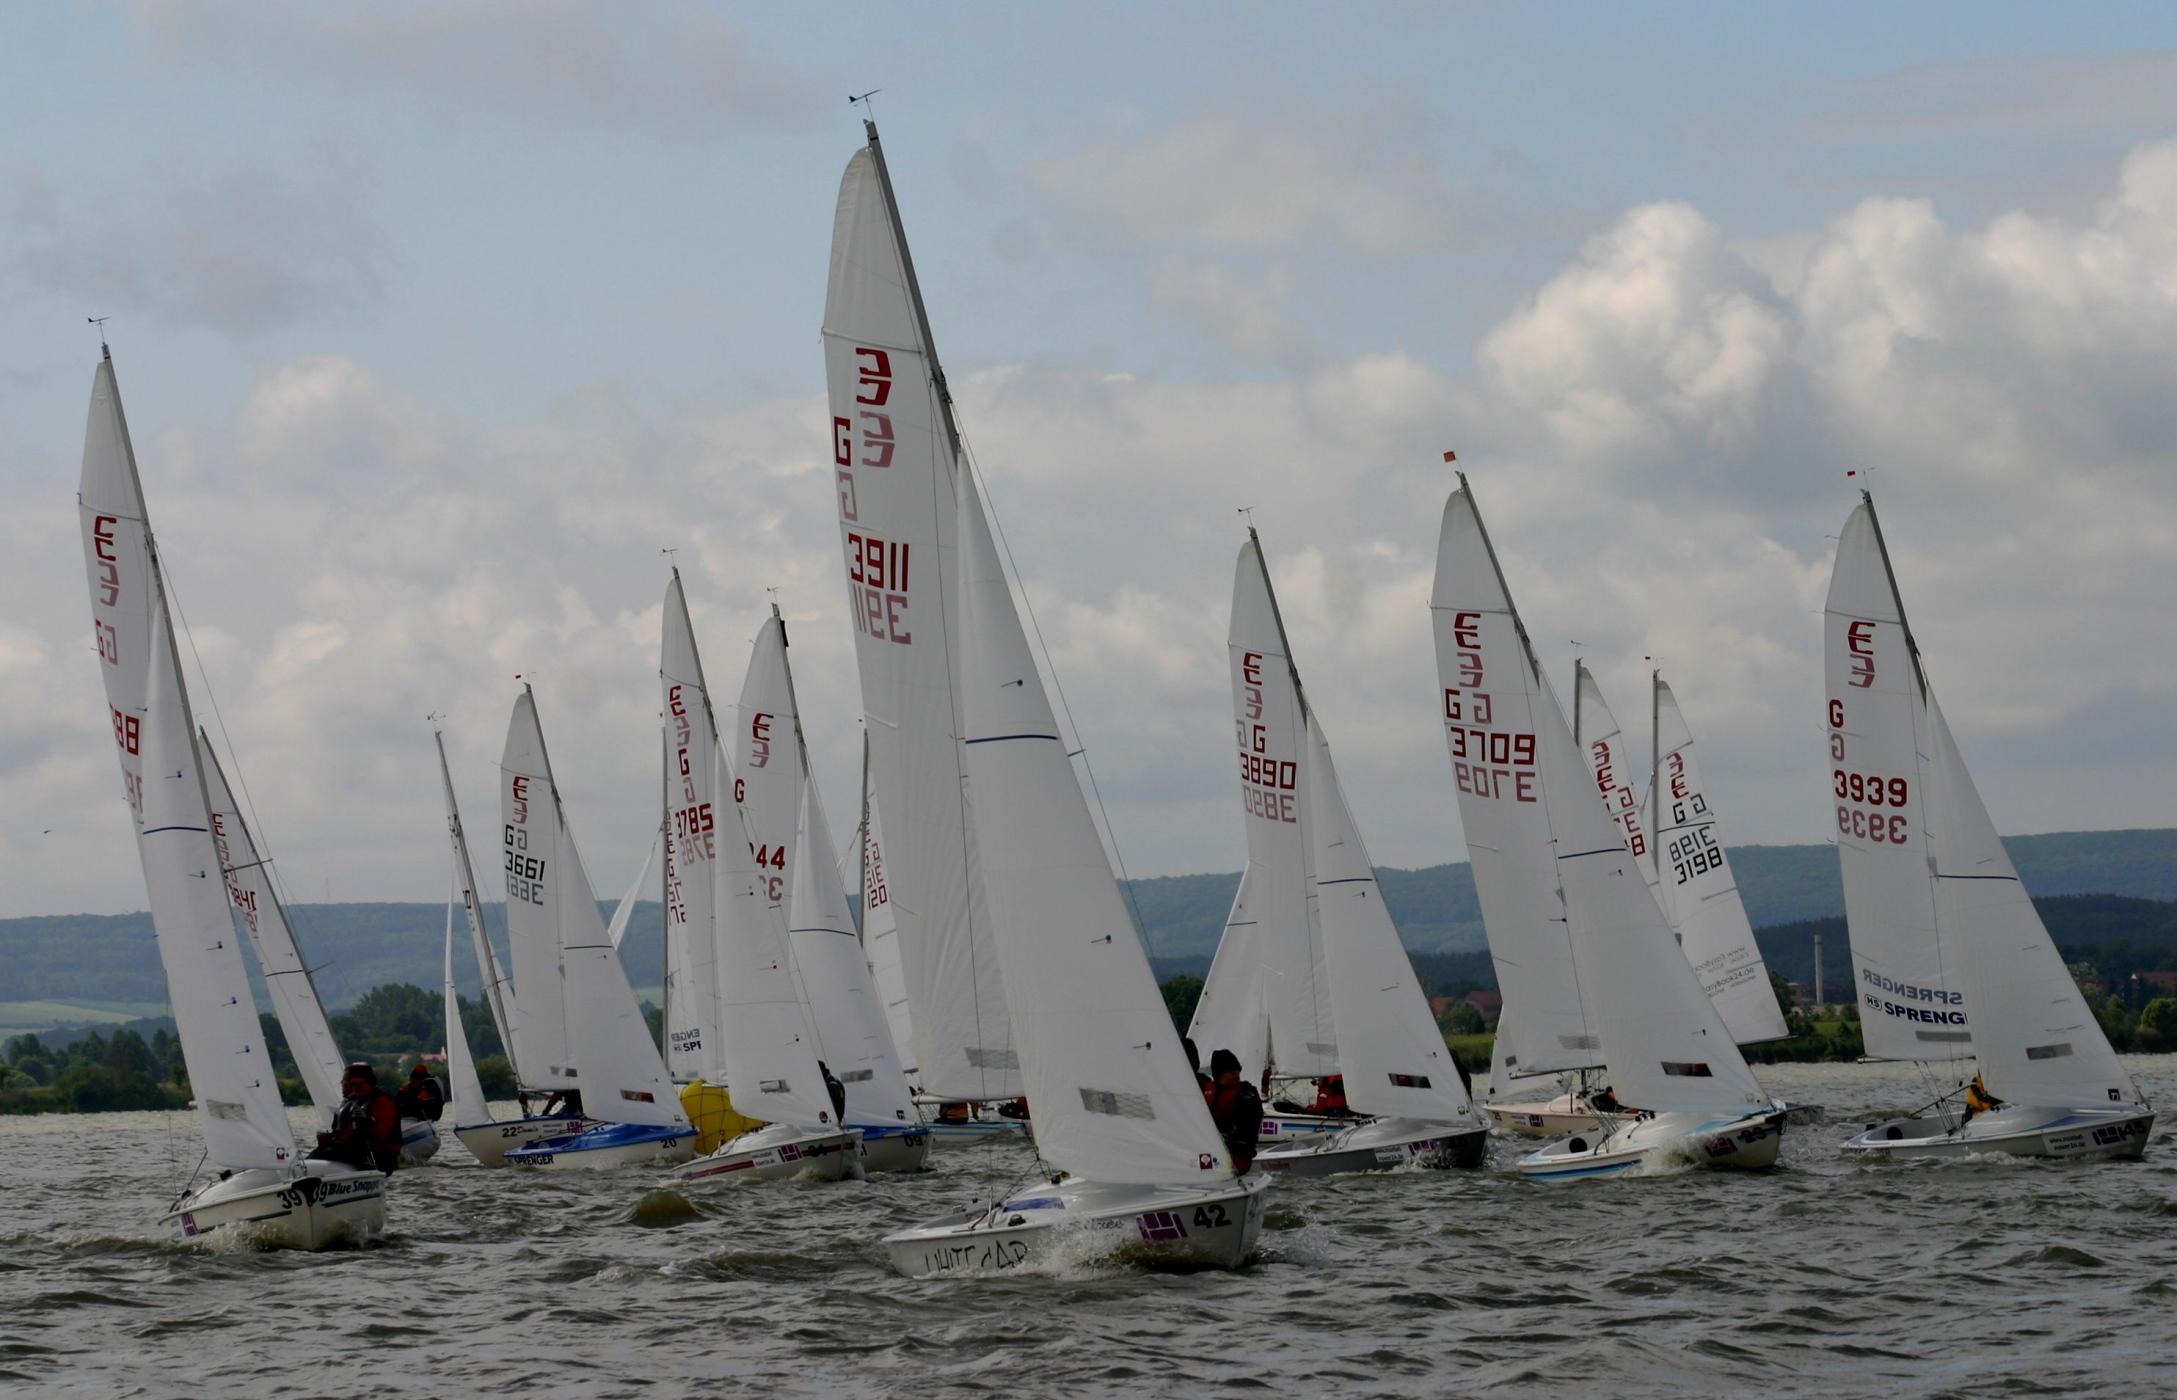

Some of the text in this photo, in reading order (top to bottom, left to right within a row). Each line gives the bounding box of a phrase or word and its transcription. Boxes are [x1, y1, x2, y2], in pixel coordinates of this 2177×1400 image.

[833, 416, 851, 467] G
[848, 532, 909, 593] 3911
[1445, 688, 1461, 720] G
[1829, 699, 1844, 728] G
[1253, 724, 1266, 753] G
[1450, 726, 1536, 766] 3709
[678, 748, 690, 776] G
[1240, 752, 1297, 790] 3890
[734, 778, 745, 803] G
[1833, 769, 1908, 808] 3939
[675, 802, 715, 839] 3785
[1672, 802, 1687, 824] G
[505, 824, 515, 846] G
[505, 850, 545, 881] 3661
[749, 842, 786, 870] 44
[1674, 846, 1723, 885] 3198
[1884, 1001, 1969, 1025] SPRENG
[502, 1127, 517, 1138] 22
[660, 1137, 678, 1149] 20
[277, 1188, 303, 1209] 39
[327, 1181, 352, 1196] Blue
[1194, 1205, 1232, 1229] 42
